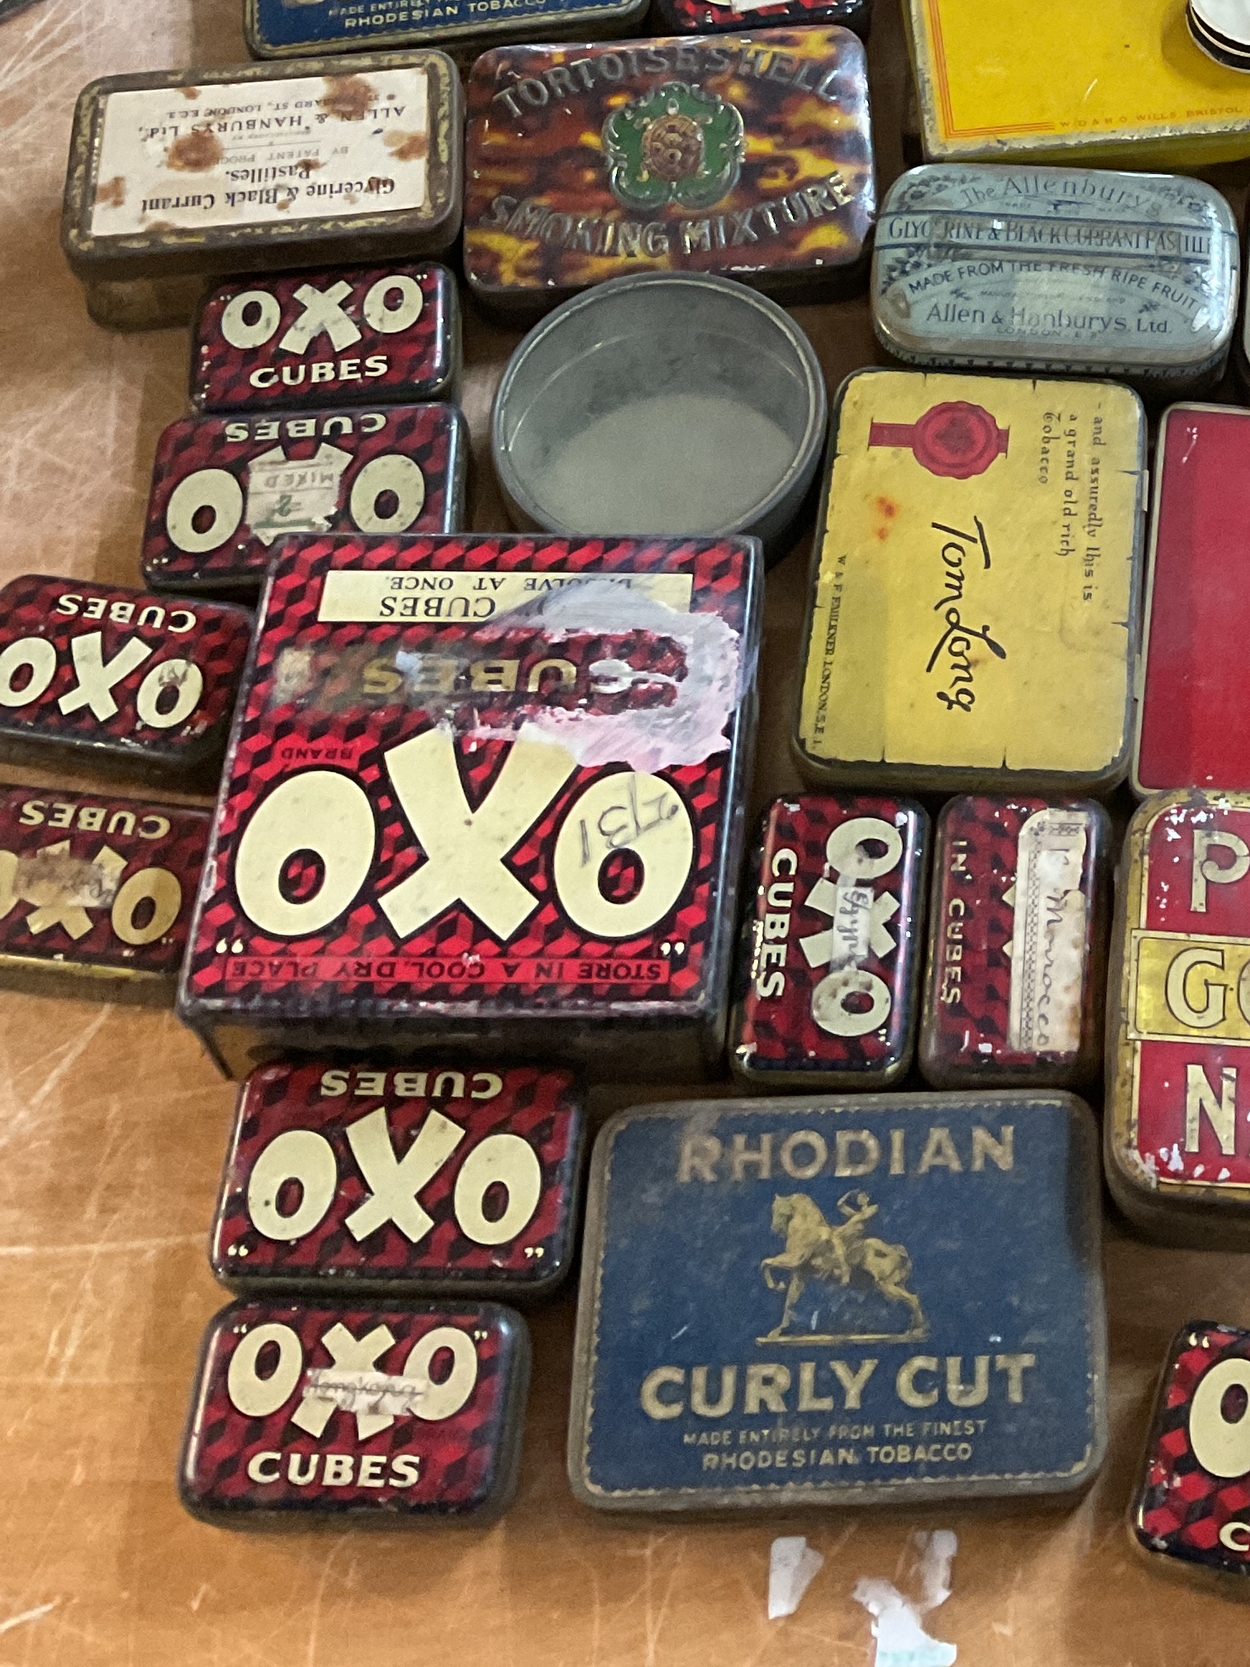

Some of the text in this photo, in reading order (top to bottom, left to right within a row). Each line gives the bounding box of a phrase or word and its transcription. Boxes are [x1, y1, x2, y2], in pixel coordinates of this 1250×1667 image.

[328, 4, 366, 17] MADE
[344, 4, 458, 29] RHODESIAN
[493, 45, 843, 119] TORTOISESHELL
[191, 115, 301, 135] HANBURYS
[266, 146, 348, 161] BY PATENT
[225, 165, 311, 183] Pastilles.
[142, 176, 396, 212] Glycerine & Black Currant
[961, 186, 997, 205] The
[480, 170, 854, 258] SMOKING MIXTURE
[889, 218, 984, 241] GLYCRINE
[1006, 222, 1061, 244] BLACK
[908, 261, 1199, 310] MADE FROM THE FRESH RIPE FRUIT
[222, 274, 424, 354] OXO
[927, 303, 985, 324] Allen
[991, 312, 1003, 324] &
[250, 356, 388, 388] CUBES
[224, 413, 387, 443] CUBES
[1059, 429, 1083, 480] grand
[1062, 489, 1079, 516] old
[474, 575, 505, 591] AT
[56, 594, 196, 633] CUBES
[379, 595, 496, 620] CUBES
[824, 595, 840, 657] FAULKNER
[0, 631, 203, 728] OXO
[362, 657, 633, 694] CUBES
[281, 745, 353, 762] BRAND
[19, 800, 170, 839] CUBES
[235, 720, 693, 941] OXO
[0, 839, 182, 945] XO
[756, 848, 798, 998] CUBES
[941, 840, 967, 1005] IN CUBES
[232, 960, 319, 978] PLACE
[337, 960, 396, 979] DRY
[501, 962, 519, 979] A
[534, 962, 564, 980] IN
[578, 962, 661, 980] STORE
[320, 1069, 502, 1099] CUBES
[676, 1125, 1015, 1183] RHODIAN
[247, 1106, 542, 1245] OXO
[228, 1322, 478, 1441] OXO
[639, 1353, 1036, 1420] CURLY CUT
[683, 1418, 988, 1447] MADE ENTIRELY FROM THE FINEST
[248, 1451, 420, 1489] CUBES
[701, 1441, 974, 1472] RHODESIAN TOBACCO
